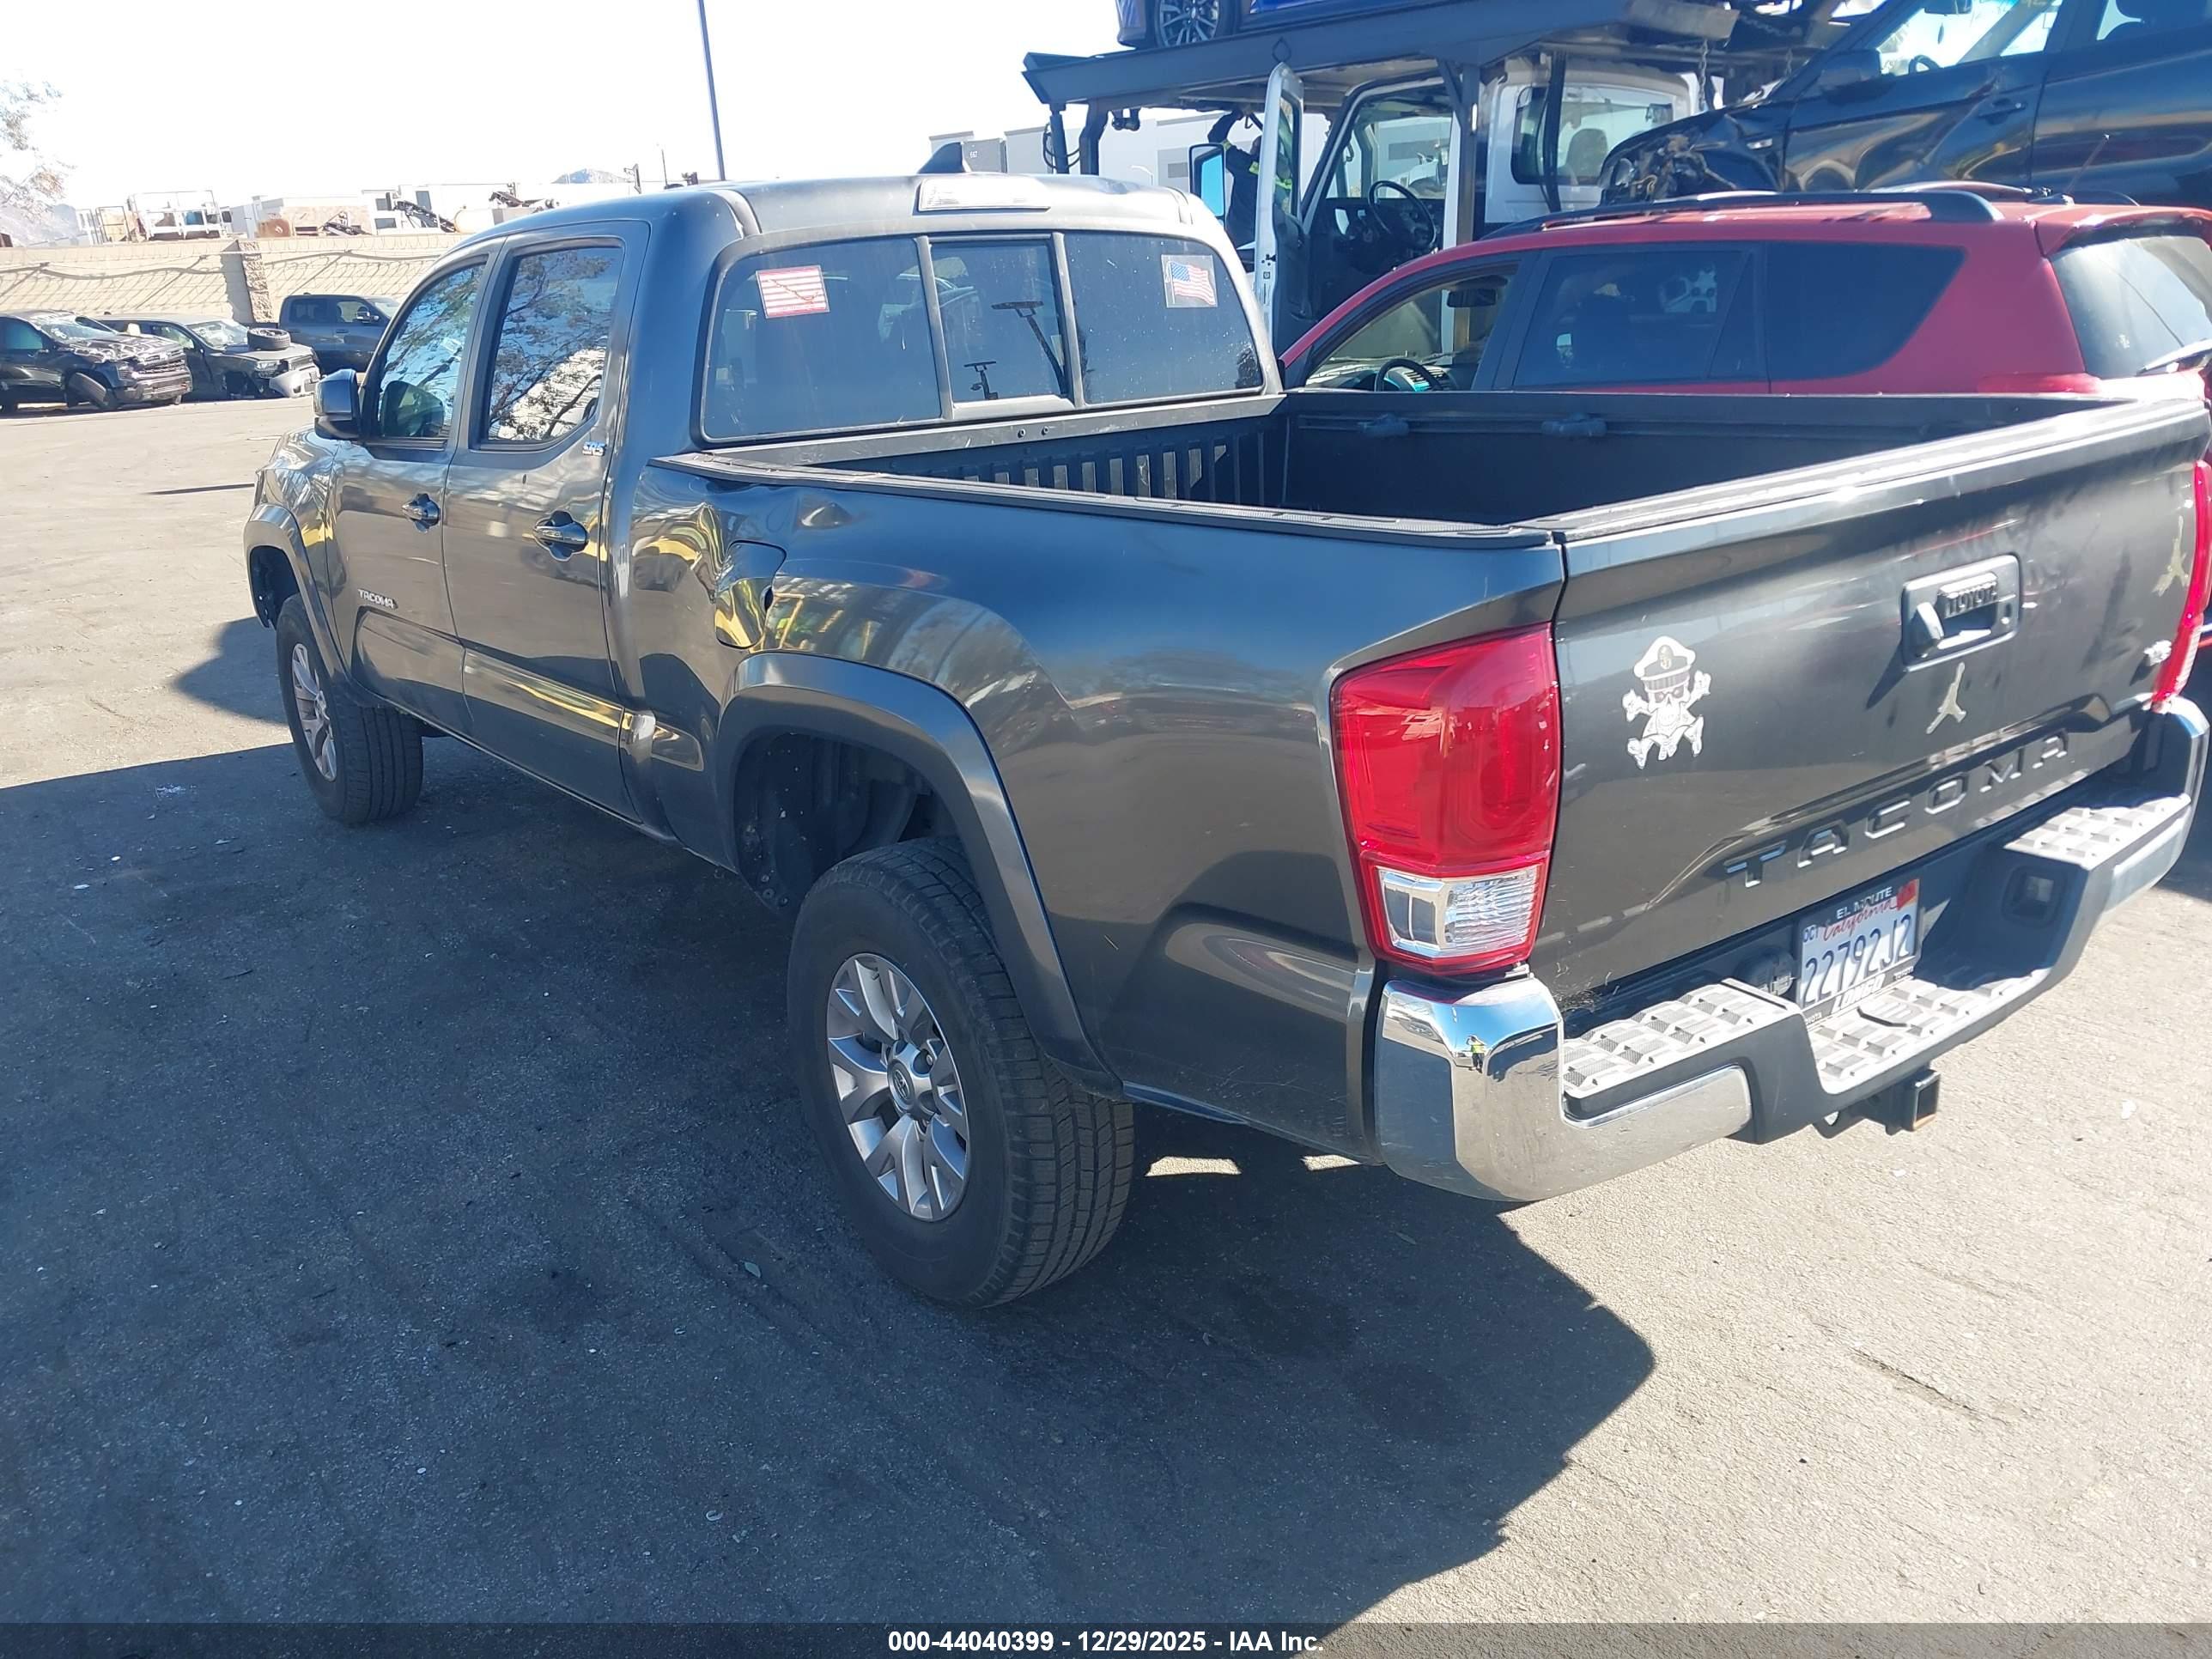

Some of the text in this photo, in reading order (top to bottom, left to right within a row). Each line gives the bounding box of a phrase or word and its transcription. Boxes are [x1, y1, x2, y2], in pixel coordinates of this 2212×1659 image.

[357, 588, 396, 610] TACOMA
[1724, 730, 2069, 889] TACOMA
[1822, 898, 1899, 942] California
[1805, 914, 1911, 1006] 22792J2
